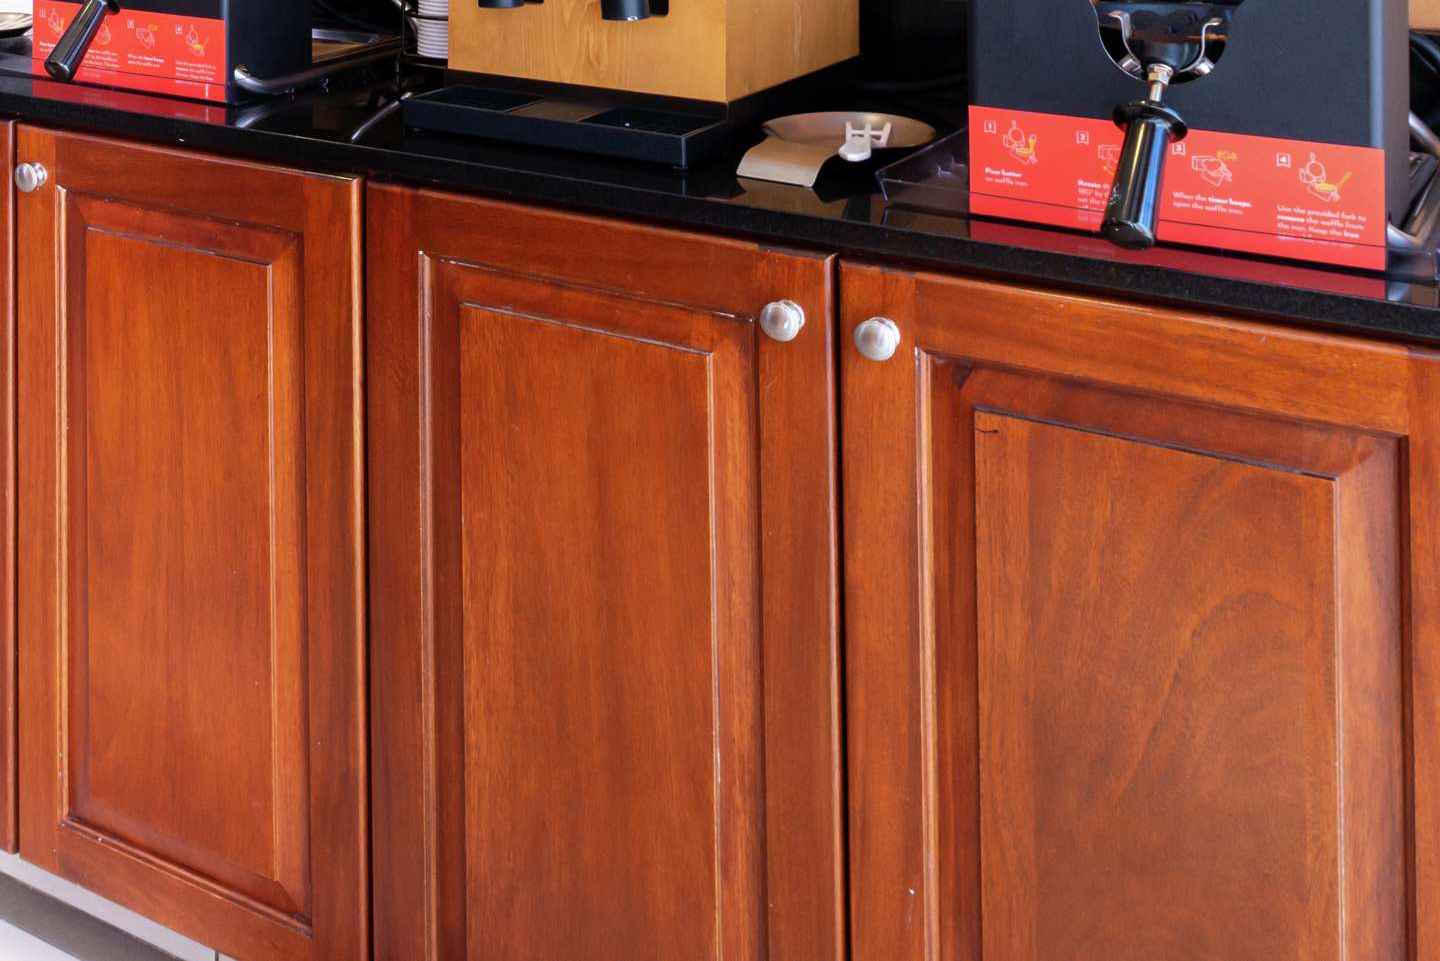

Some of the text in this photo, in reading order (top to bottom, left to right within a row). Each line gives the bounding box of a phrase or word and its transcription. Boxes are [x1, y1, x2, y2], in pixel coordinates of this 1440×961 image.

[1172, 191, 1194, 199] When
[1194, 193, 1207, 201] the
[1207, 195, 1228, 204] timer
[1192, 202, 1204, 210] the
[1205, 204, 1227, 213] waffle
[1276, 205, 1292, 213] Use
[1293, 206, 1306, 214] the
[1307, 209, 1340, 219] provided
[1341, 212, 1357, 221] fork
[1306, 216, 1320, 224] the
[1320, 219, 1344, 228] waffle
